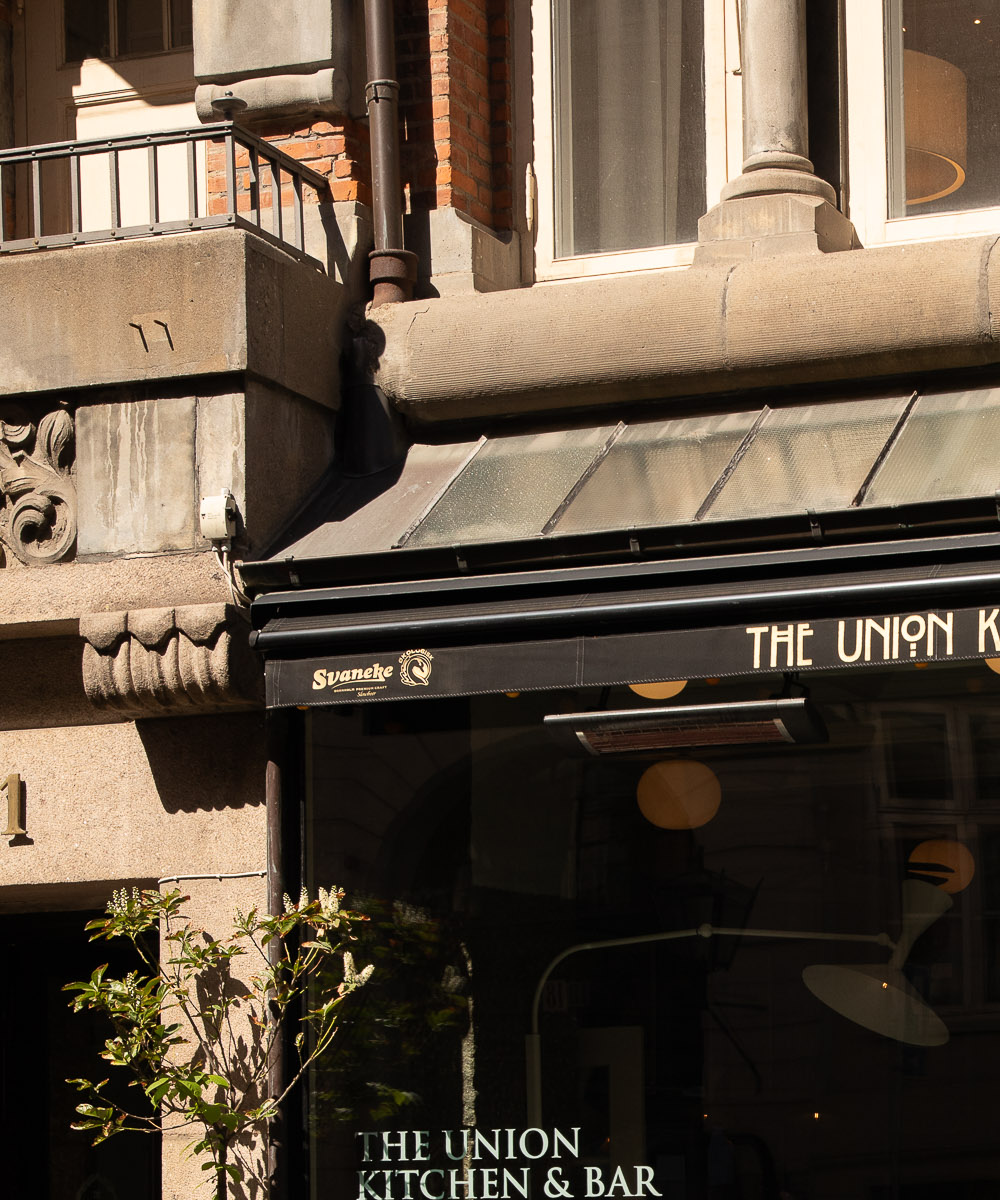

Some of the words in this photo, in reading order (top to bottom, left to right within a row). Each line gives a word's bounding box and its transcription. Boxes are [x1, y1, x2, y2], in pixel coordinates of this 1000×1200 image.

[745, 622, 814, 669] THE
[837, 611, 954, 663] UNION
[312, 662, 394, 690] Svaneke
[355, 1130, 432, 1162] THE
[441, 1127, 581, 1161] UNION
[356, 1167, 531, 1200] KITCHEN
[543, 1166, 575, 1200] &
[583, 1165, 663, 1198] BAR
